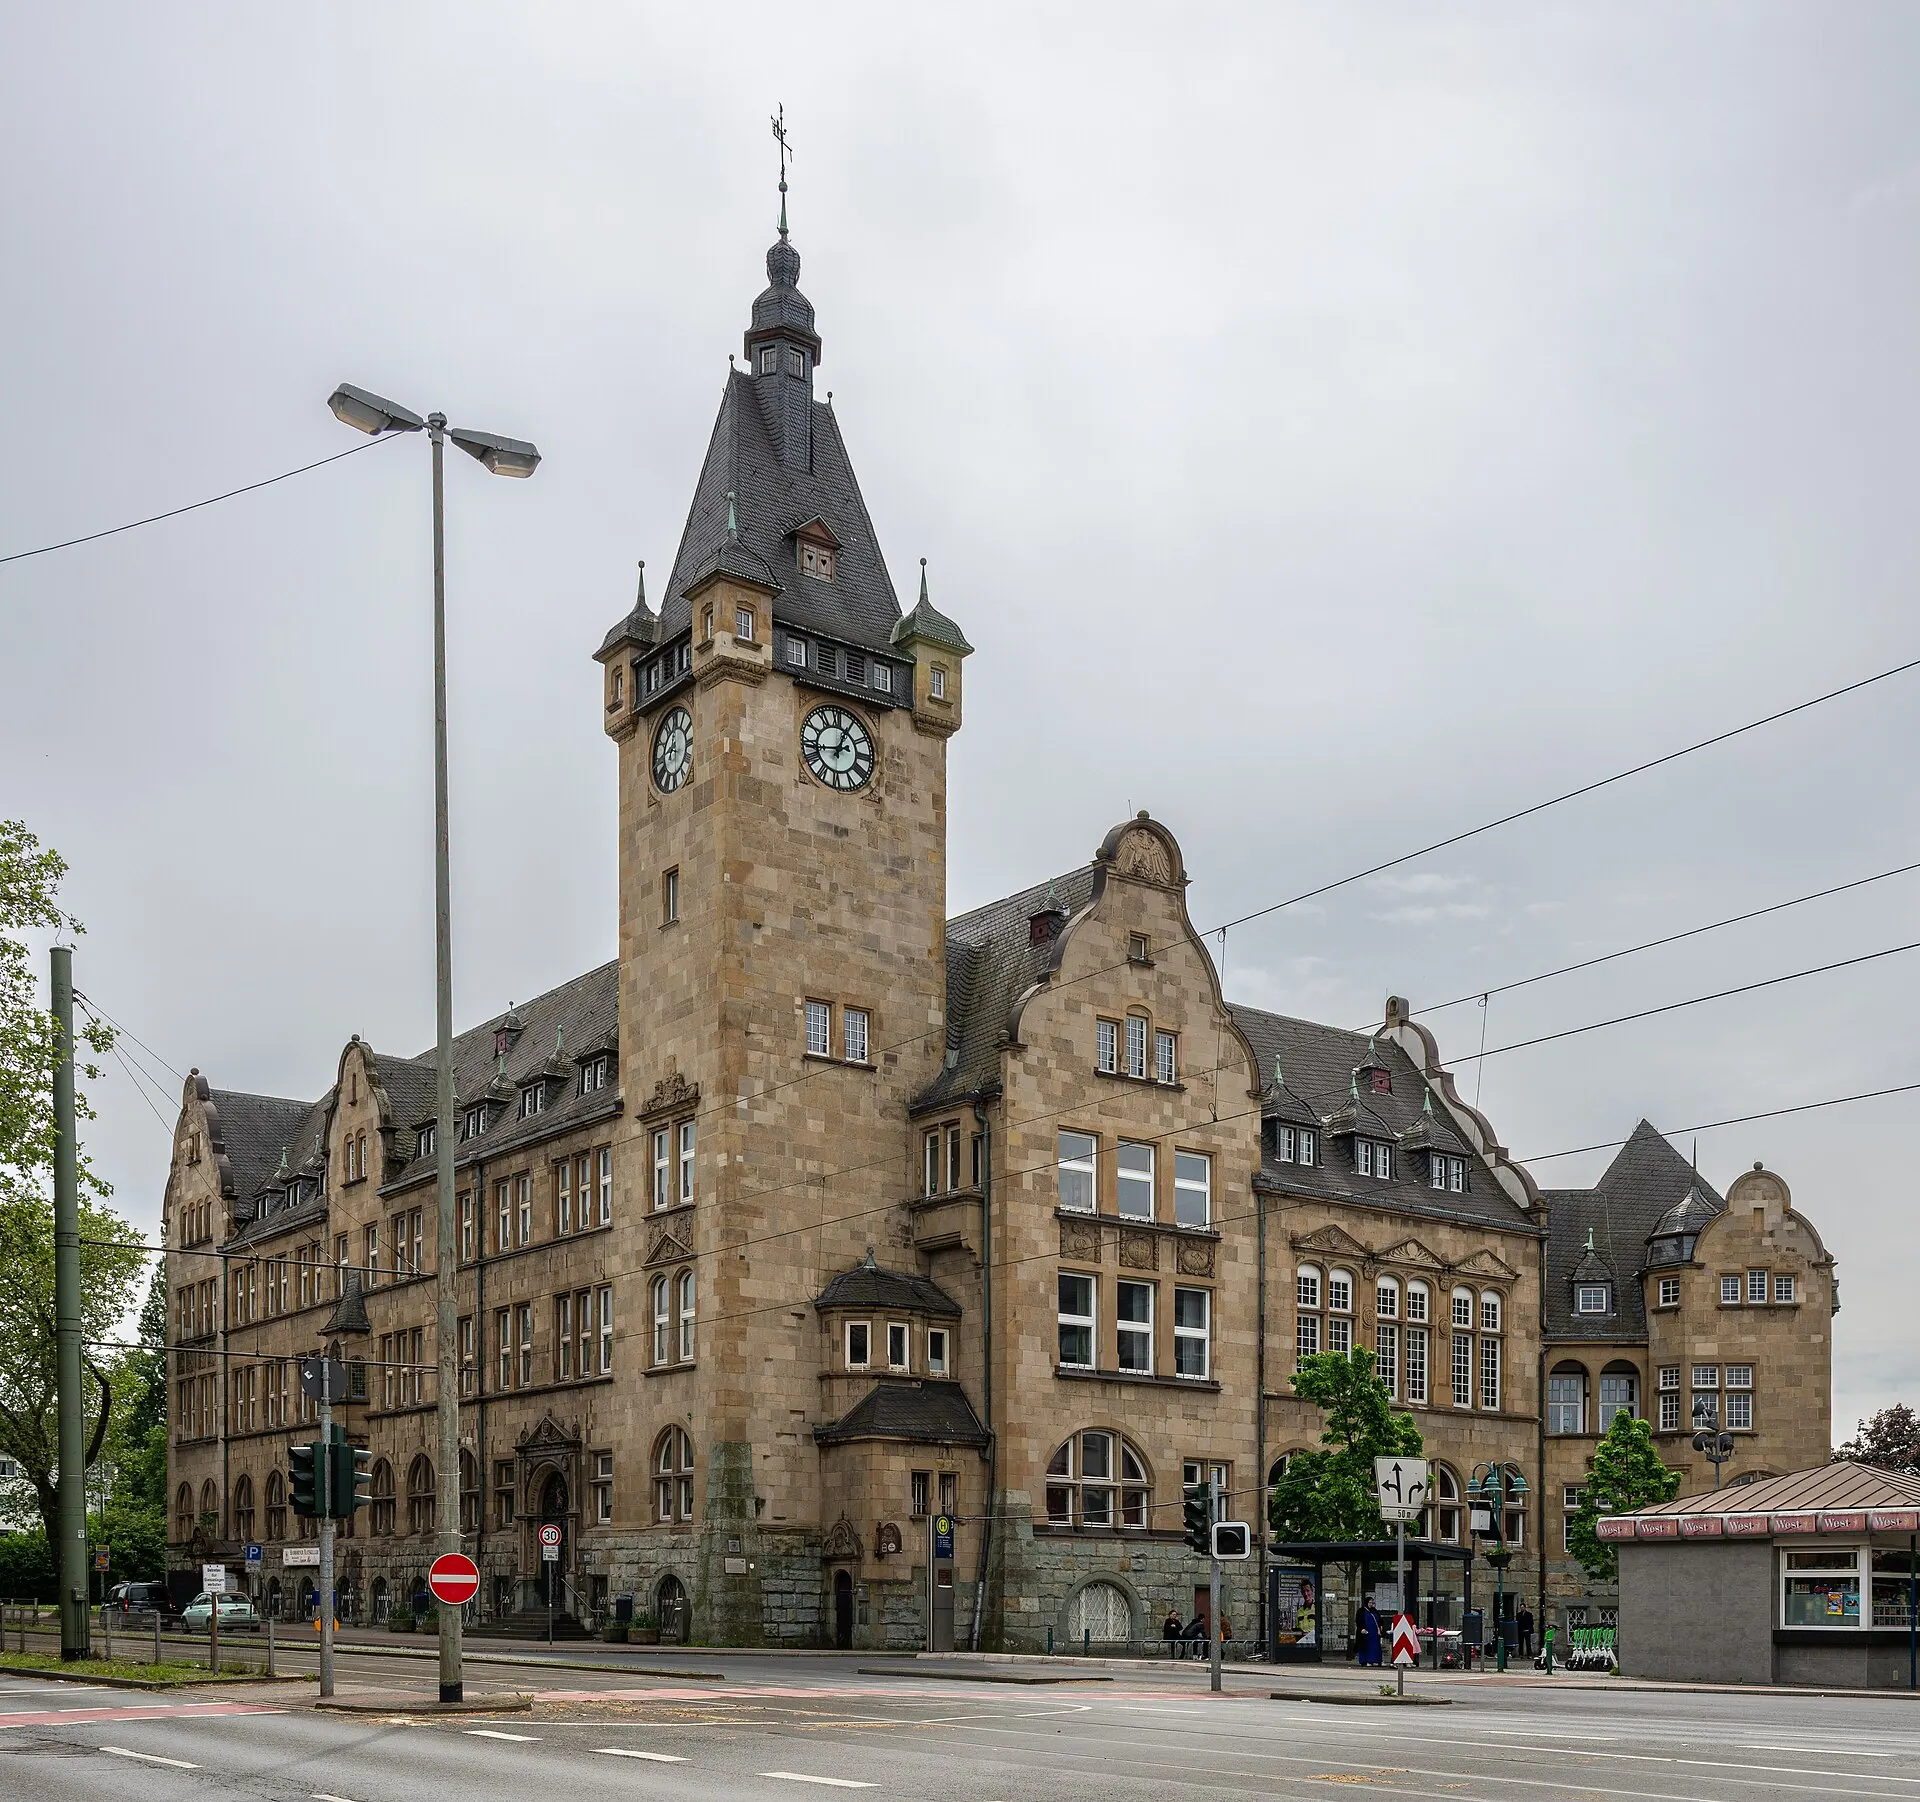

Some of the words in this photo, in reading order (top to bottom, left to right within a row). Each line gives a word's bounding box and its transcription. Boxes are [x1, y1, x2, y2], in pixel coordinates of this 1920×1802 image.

[1398, 1510, 1405, 1518] 50
[1728, 1520, 1752, 1532] West
[1775, 1518, 1800, 1529] West
[1824, 1517, 1849, 1528] West
[1874, 1515, 1900, 1527] West
[1599, 1525, 1621, 1536] West
[1641, 1524, 1663, 1535] West
[1684, 1521, 1707, 1533] West
[544, 1531, 556, 1540] 30
[250, 1547, 258, 1558] P
